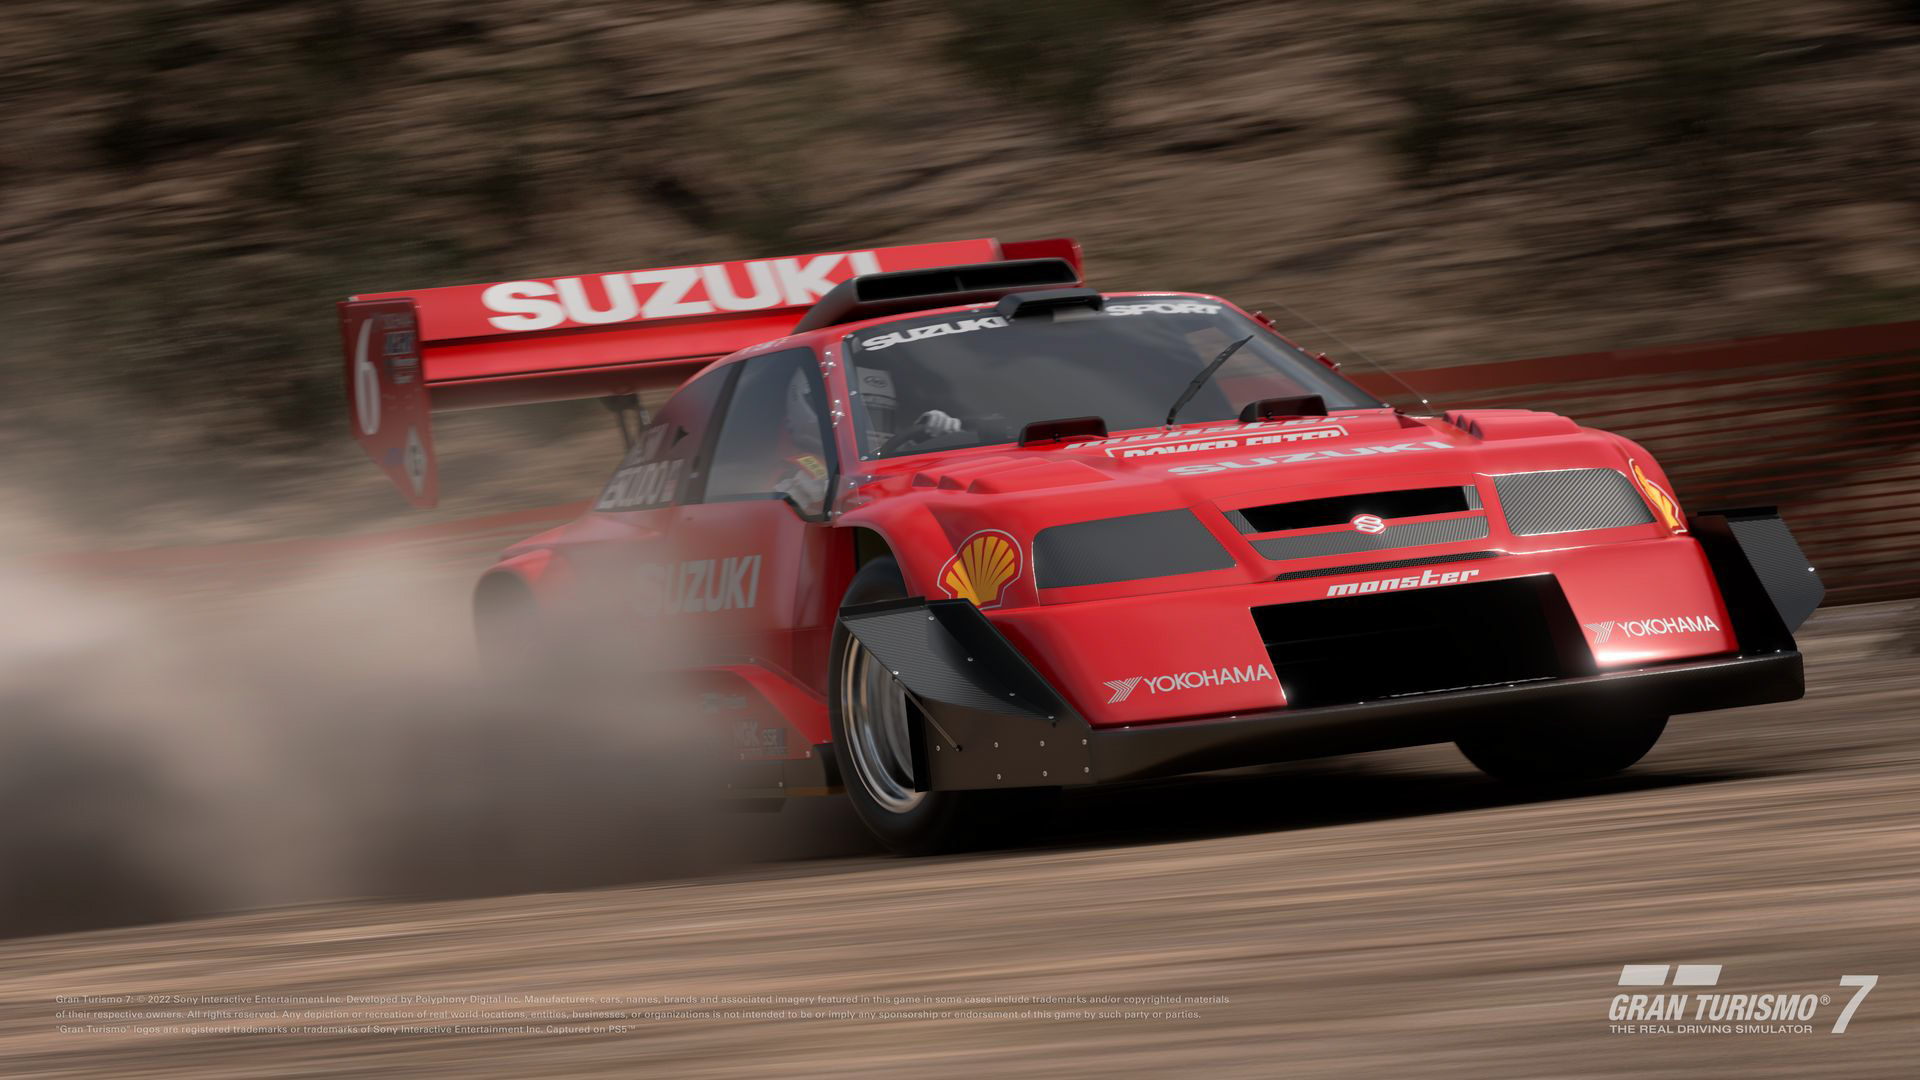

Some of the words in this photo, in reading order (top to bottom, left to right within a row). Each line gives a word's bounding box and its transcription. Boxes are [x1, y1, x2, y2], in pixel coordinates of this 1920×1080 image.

[862, 317, 1009, 351] SUZUKI
[1104, 303, 1222, 317] SPORT
[355, 318, 381, 435] 6
[1168, 441, 1454, 475] SUZUKI
[1327, 569, 1480, 597] monster
[1617, 615, 1720, 638] YOKOHAMA
[1143, 663, 1272, 694] YOKOHAMA
